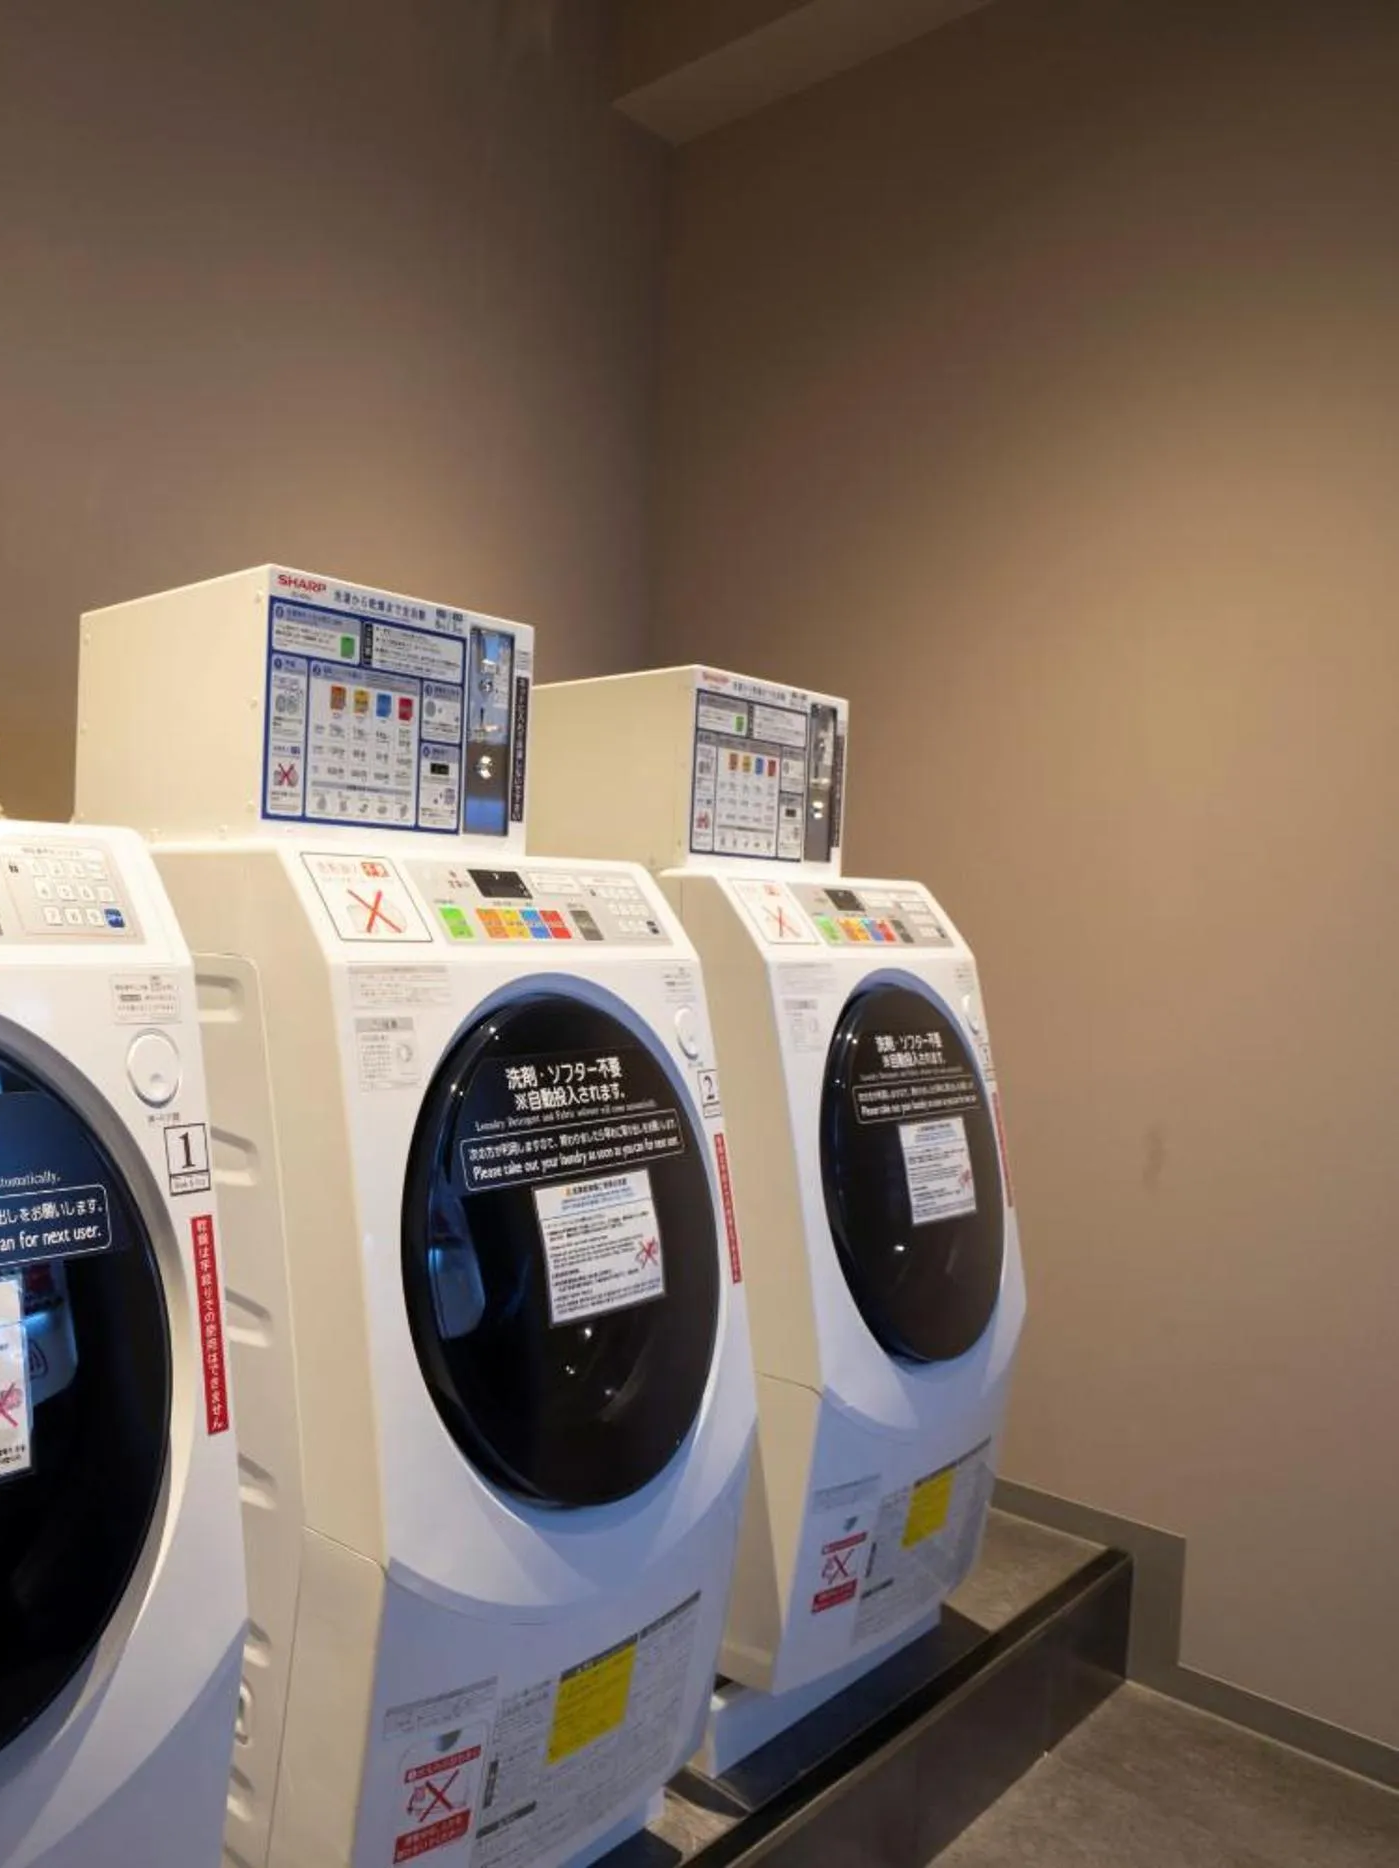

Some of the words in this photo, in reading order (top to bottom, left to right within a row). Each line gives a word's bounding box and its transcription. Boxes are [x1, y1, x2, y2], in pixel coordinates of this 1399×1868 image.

[277, 574, 327, 593] SHARP
[505, 1056, 624, 1091] 洗剤・ソフター不要
[178, 1131, 197, 1169] 1
[18, 1232, 38, 1250] for
[42, 1226, 71, 1245] next
[73, 1223, 102, 1240] user.
